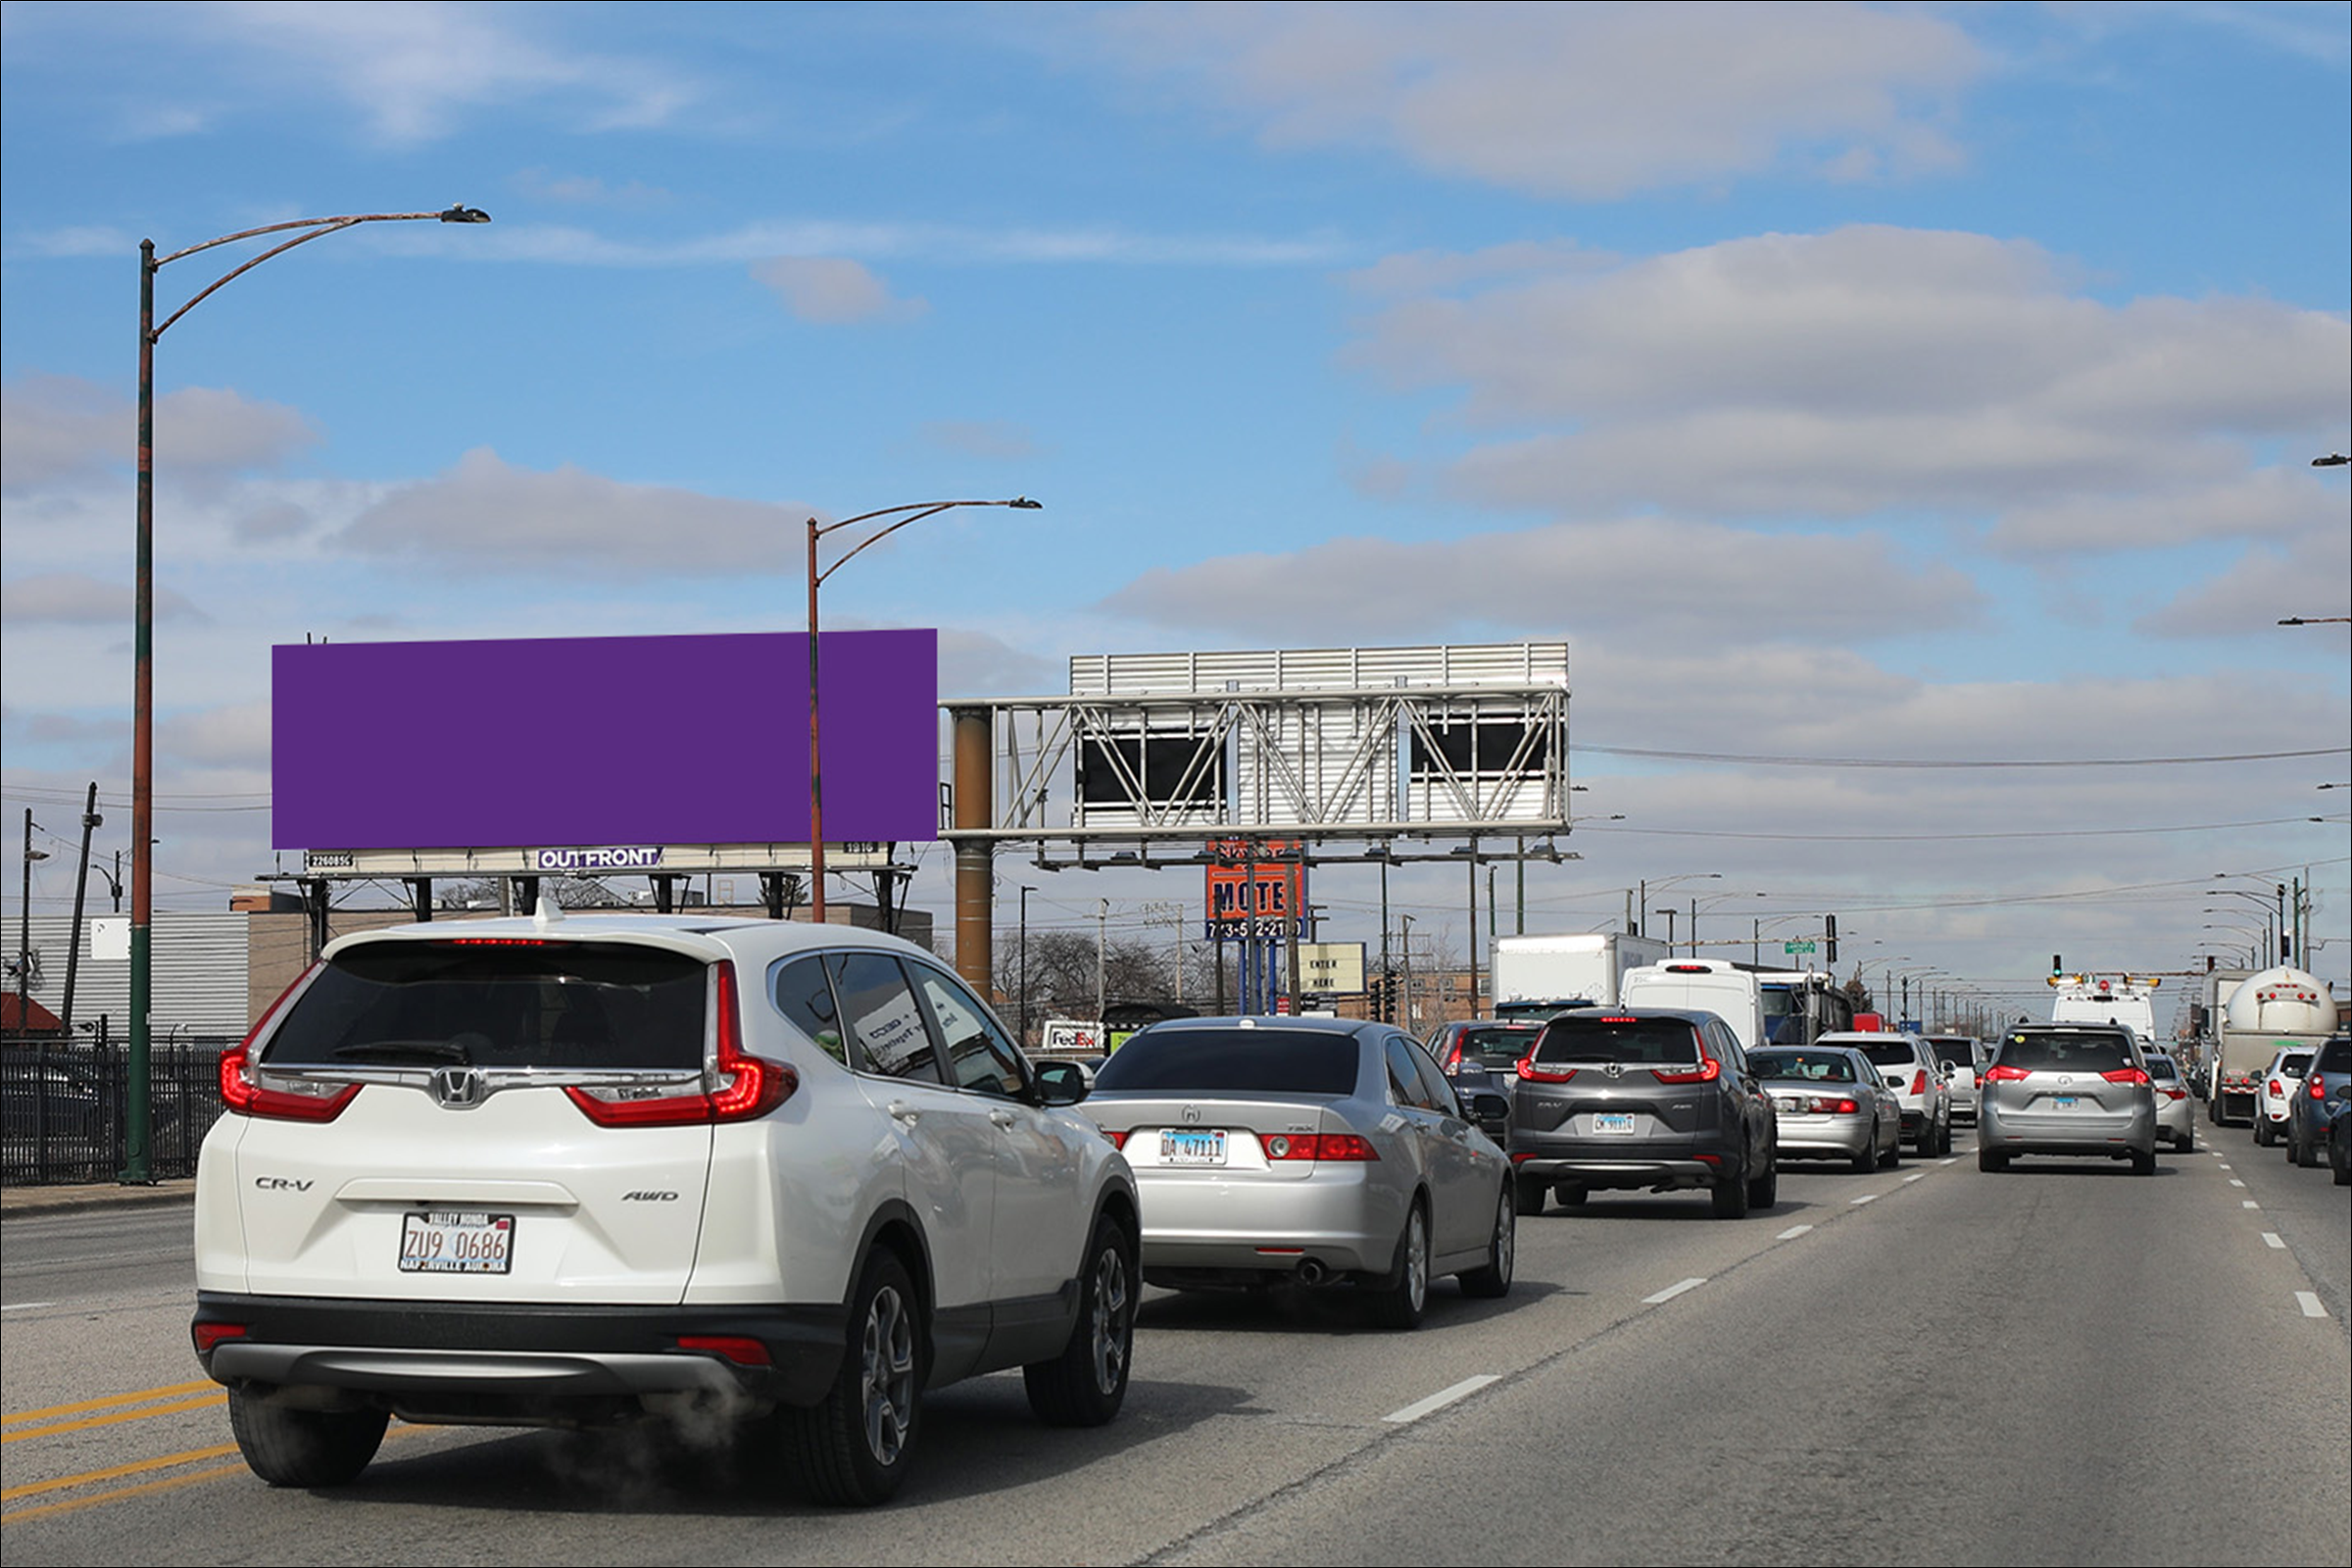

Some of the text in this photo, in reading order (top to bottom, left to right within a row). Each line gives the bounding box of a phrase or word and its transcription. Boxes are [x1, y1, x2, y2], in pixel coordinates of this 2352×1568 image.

[541, 848, 658, 867] OUTFRONT
[1213, 881, 1299, 912] MOTE
[1208, 922, 1301, 937] 73-52-21
[1309, 959, 1338, 969] ENTER
[1053, 1031, 1095, 1048] FedEx
[1160, 1138, 1222, 1157] DA 47111
[255, 1177, 315, 1192] CR-V
[620, 1191, 679, 1201] AWD
[405, 1231, 506, 1260] ZU9 0686
